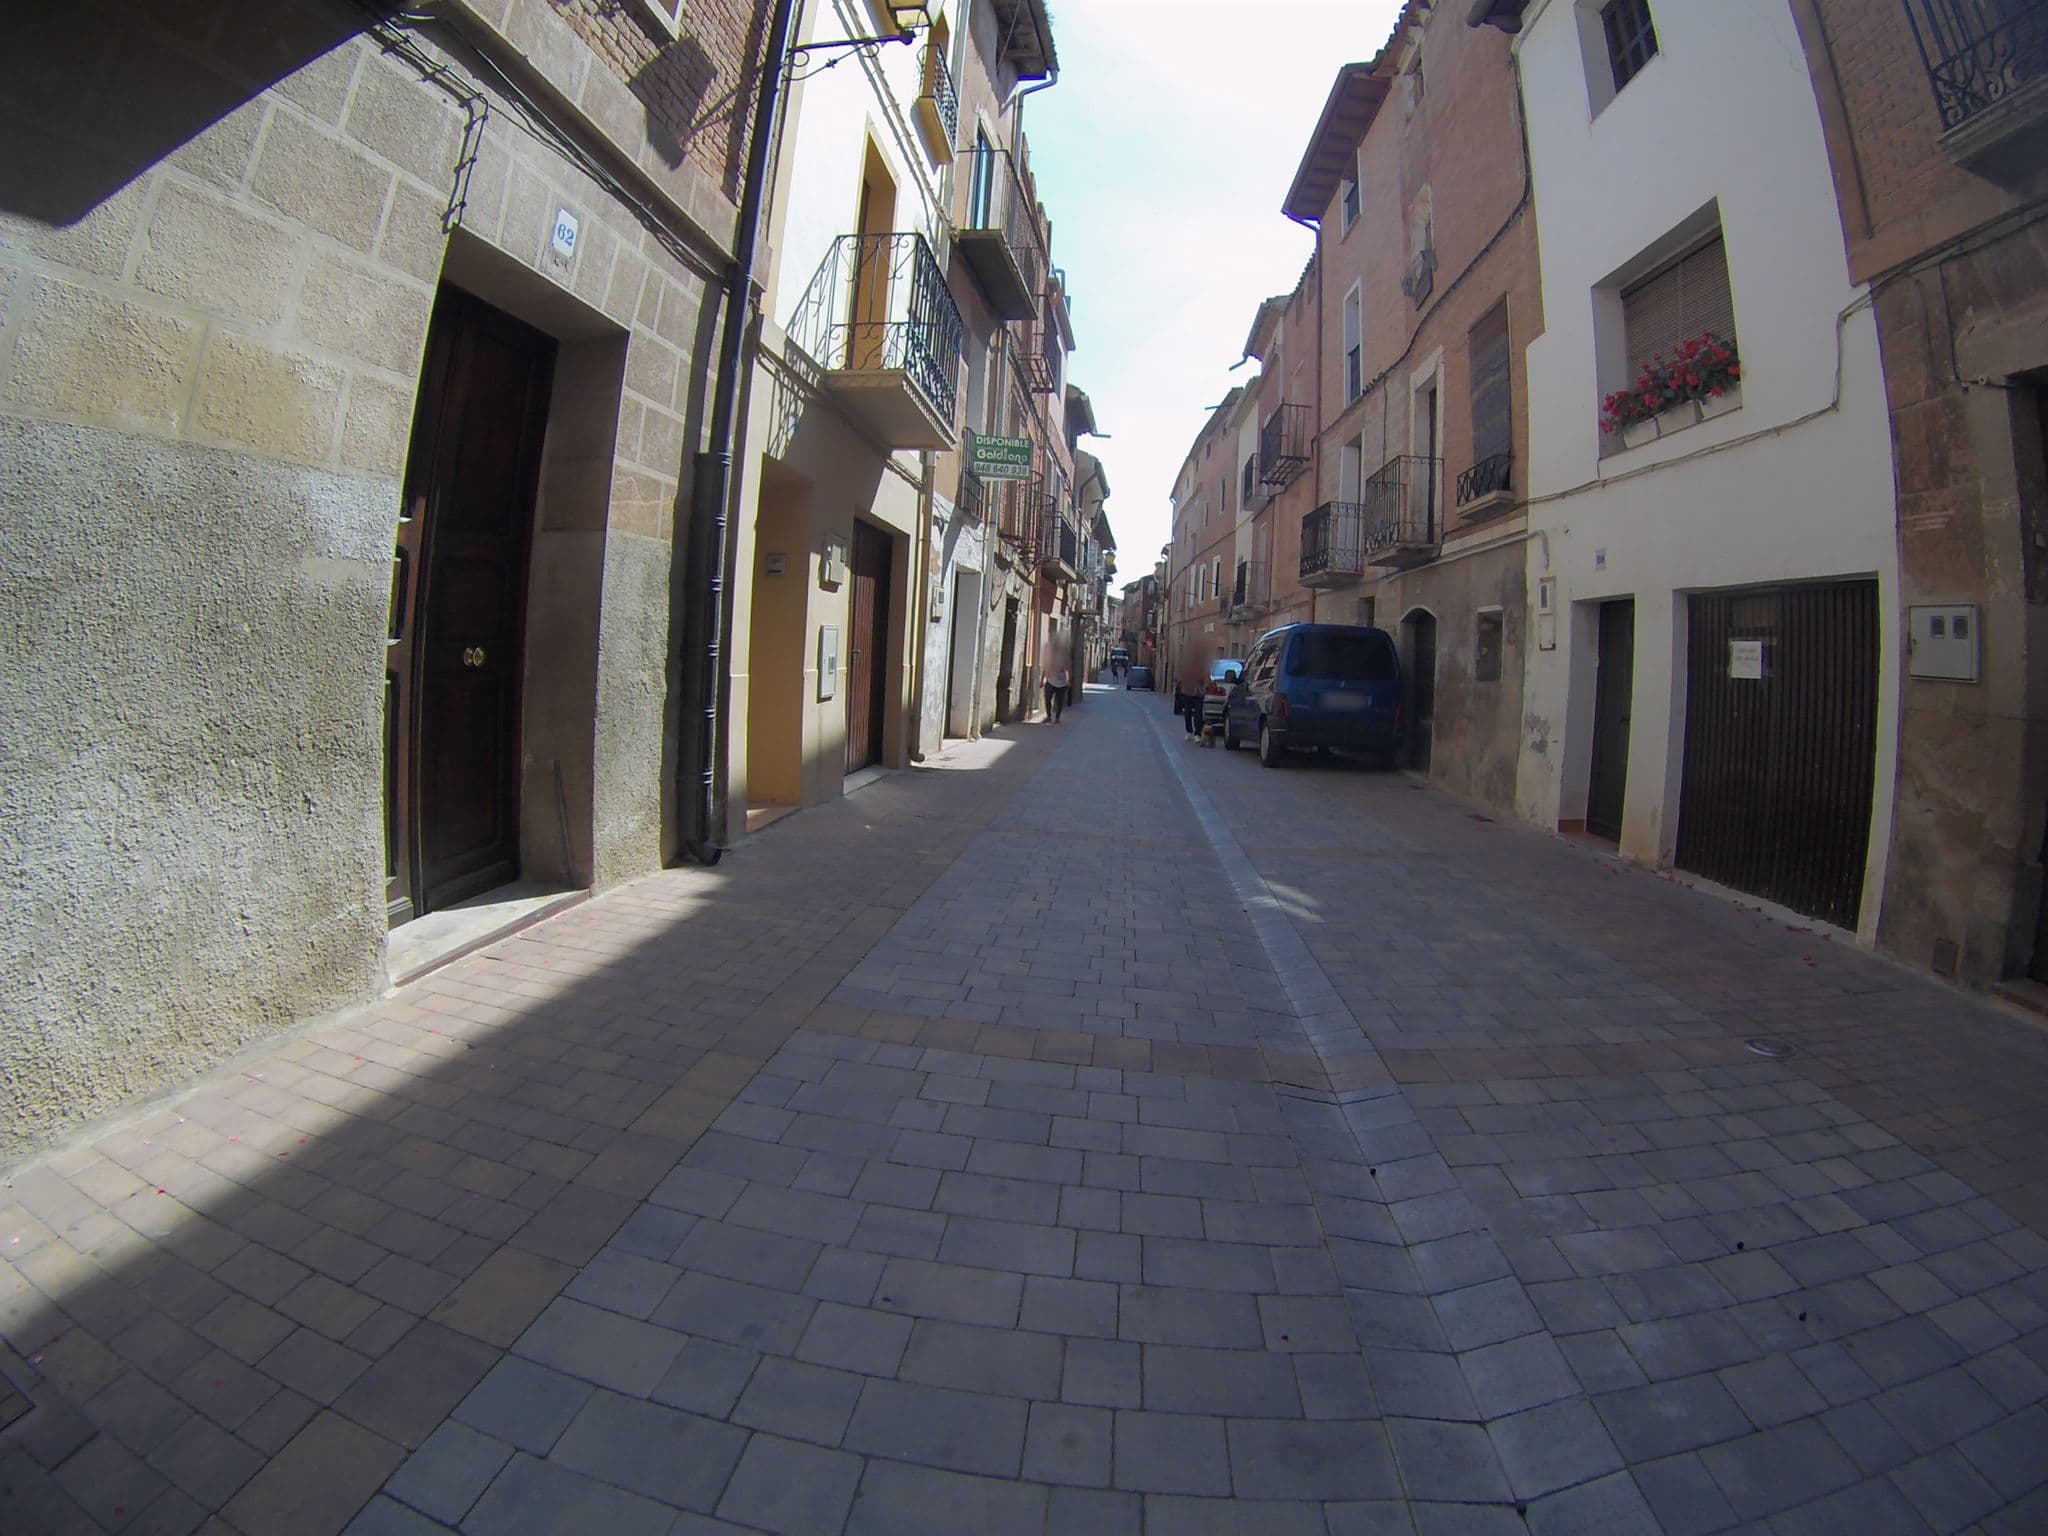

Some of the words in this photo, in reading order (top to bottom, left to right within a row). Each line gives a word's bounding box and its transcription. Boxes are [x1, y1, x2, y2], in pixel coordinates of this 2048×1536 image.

[557, 223, 575, 247] 62
[976, 436, 1030, 448] DISPONIBLE
[975, 463, 991, 473] 948
